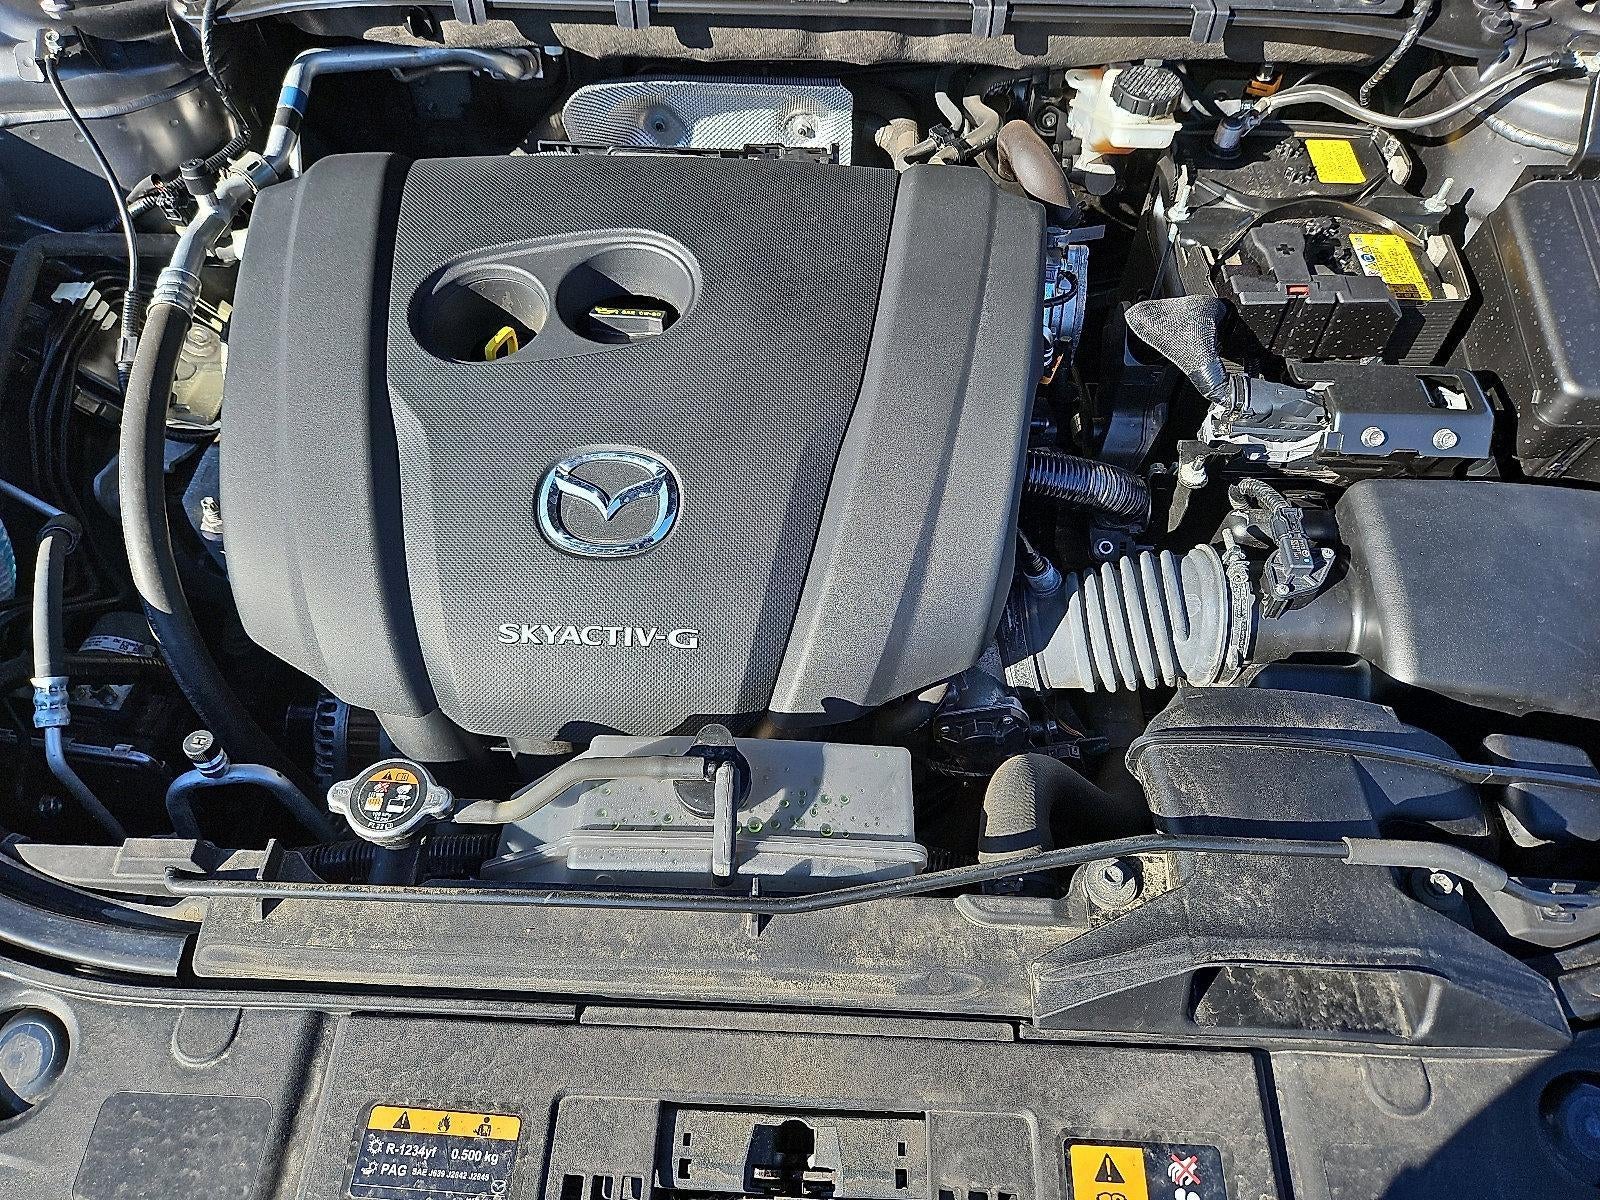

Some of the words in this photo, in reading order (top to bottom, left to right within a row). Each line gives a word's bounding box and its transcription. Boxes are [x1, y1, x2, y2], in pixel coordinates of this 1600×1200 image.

[499, 623, 700, 649] SKYACTIV-G
[385, 1142, 438, 1160] R-1234yf
[450, 1148, 482, 1163] 0.500
[483, 1150, 500, 1165] kg
[379, 1162, 408, 1177] PAG
[411, 1168, 428, 1177] SAE
